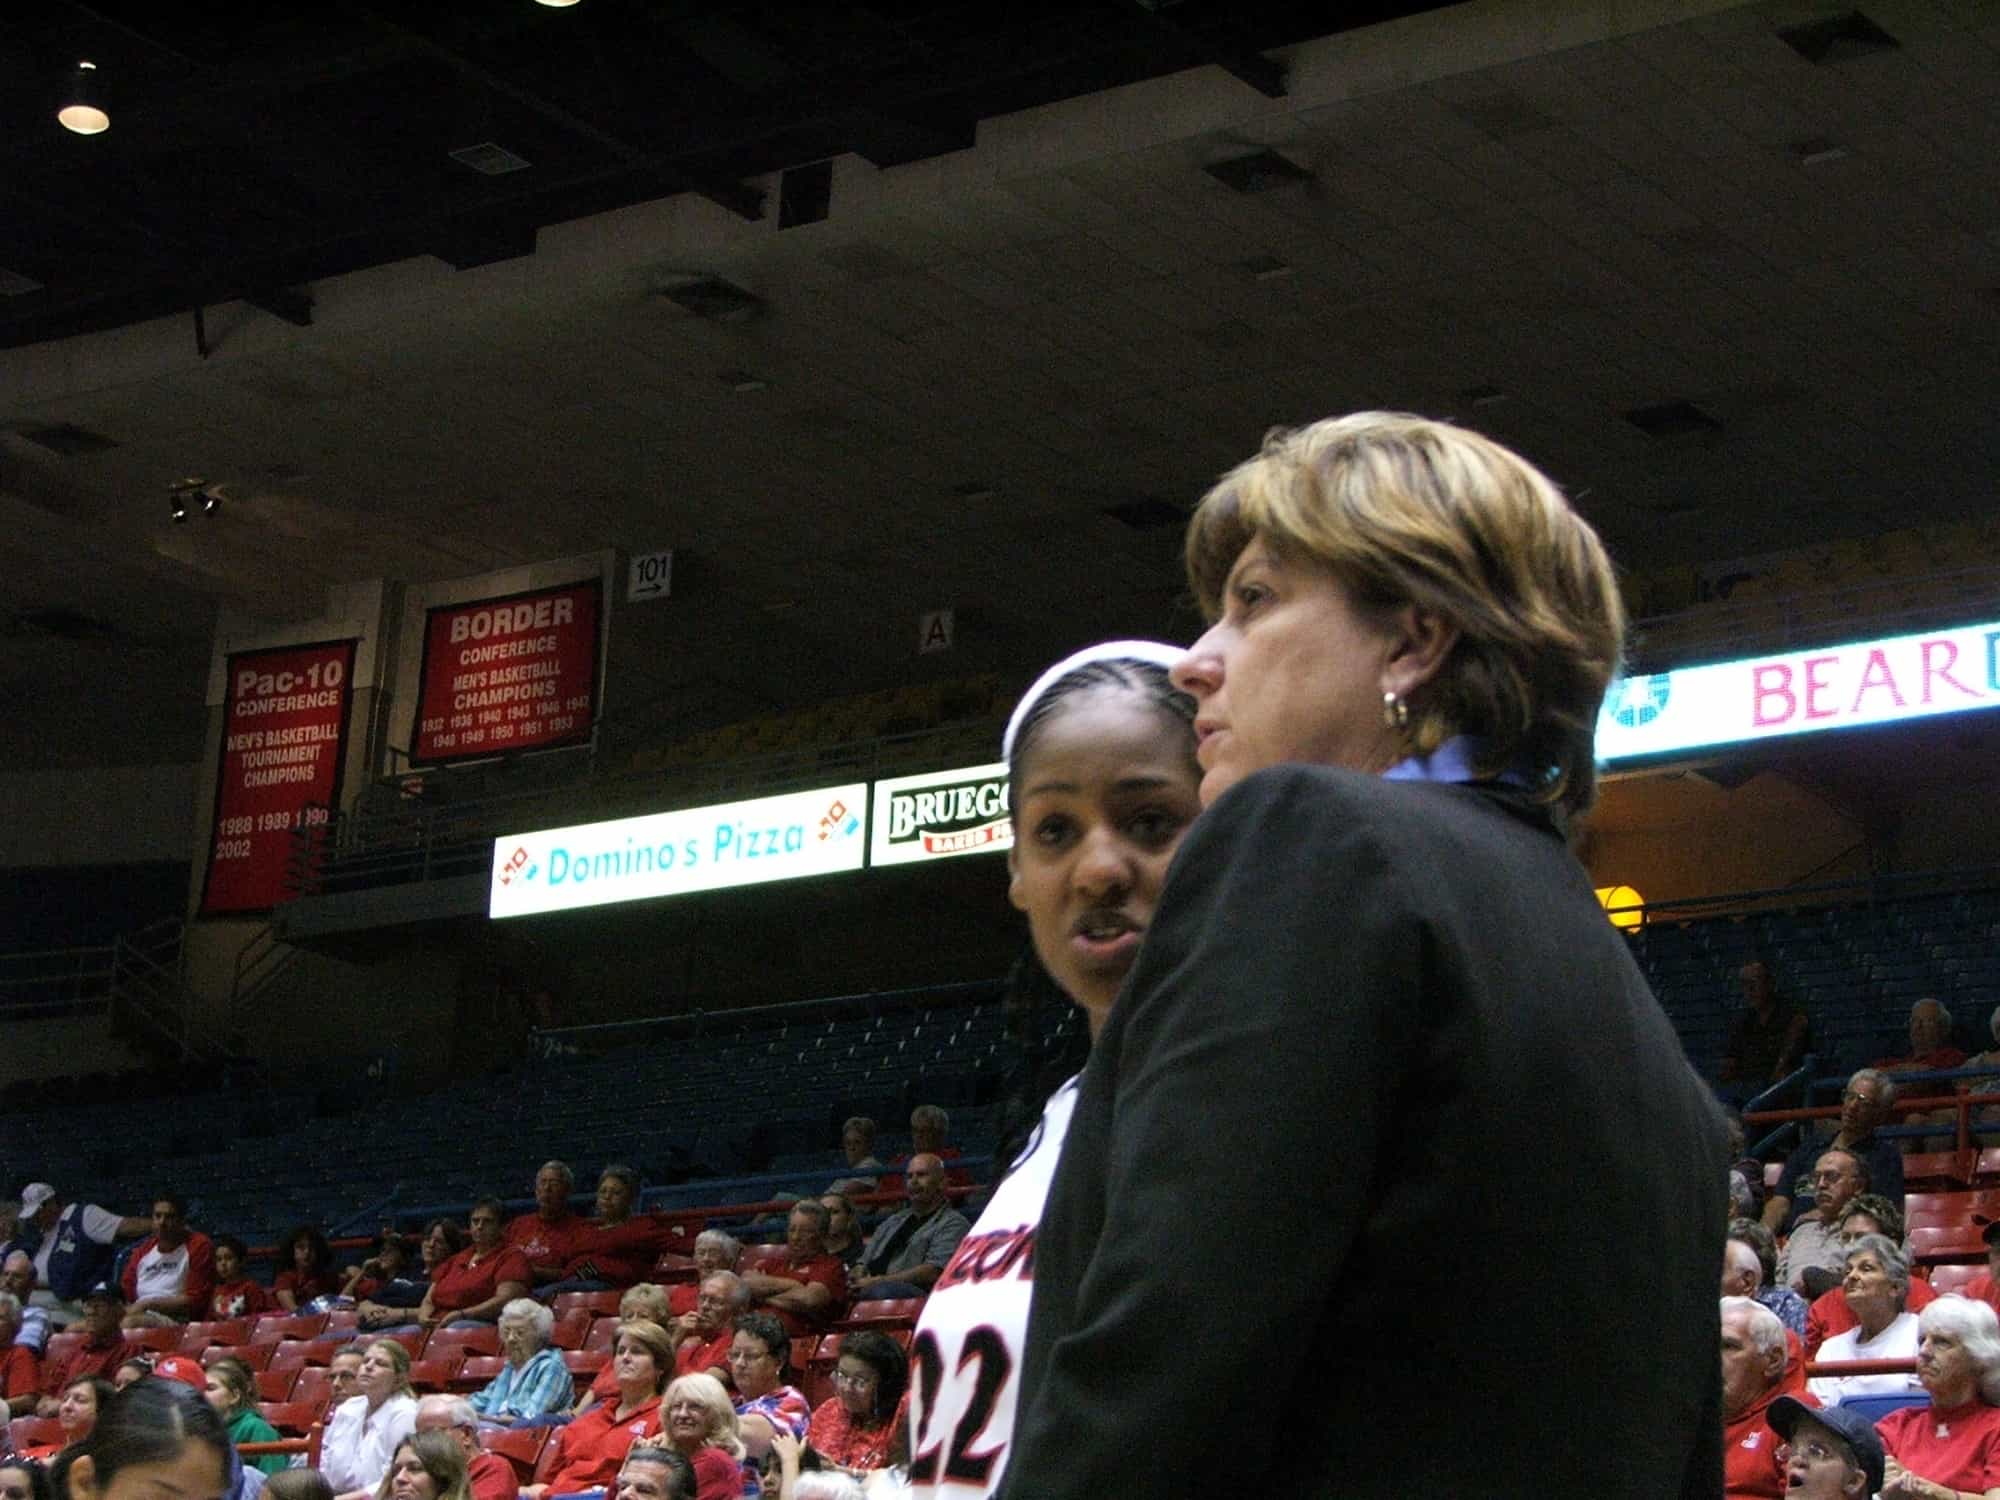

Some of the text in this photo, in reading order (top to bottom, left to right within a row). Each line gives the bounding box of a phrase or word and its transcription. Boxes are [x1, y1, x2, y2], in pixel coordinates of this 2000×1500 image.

[637, 556, 667, 585] 101
[450, 598, 575, 643] BORDER
[926, 615, 946, 646] A
[460, 635, 558, 666] CONFERENCE
[236, 659, 344, 697] Pac-10
[452, 660, 561, 691] MEN'S BASKETBALL
[1751, 638, 1985, 728] BEAR
[235, 690, 339, 718] CONFERENCE
[454, 680, 557, 710] CHAMPIONS
[226, 723, 339, 752] MEN'S BASKETBALL
[241, 743, 322, 769] TOURNAMENT
[243, 764, 315, 788] CHAMPIONS
[219, 815, 253, 836] 1988
[257, 811, 290, 832] 1989
[215, 839, 251, 860] 2002
[547, 820, 808, 887] Domino's Pizza
